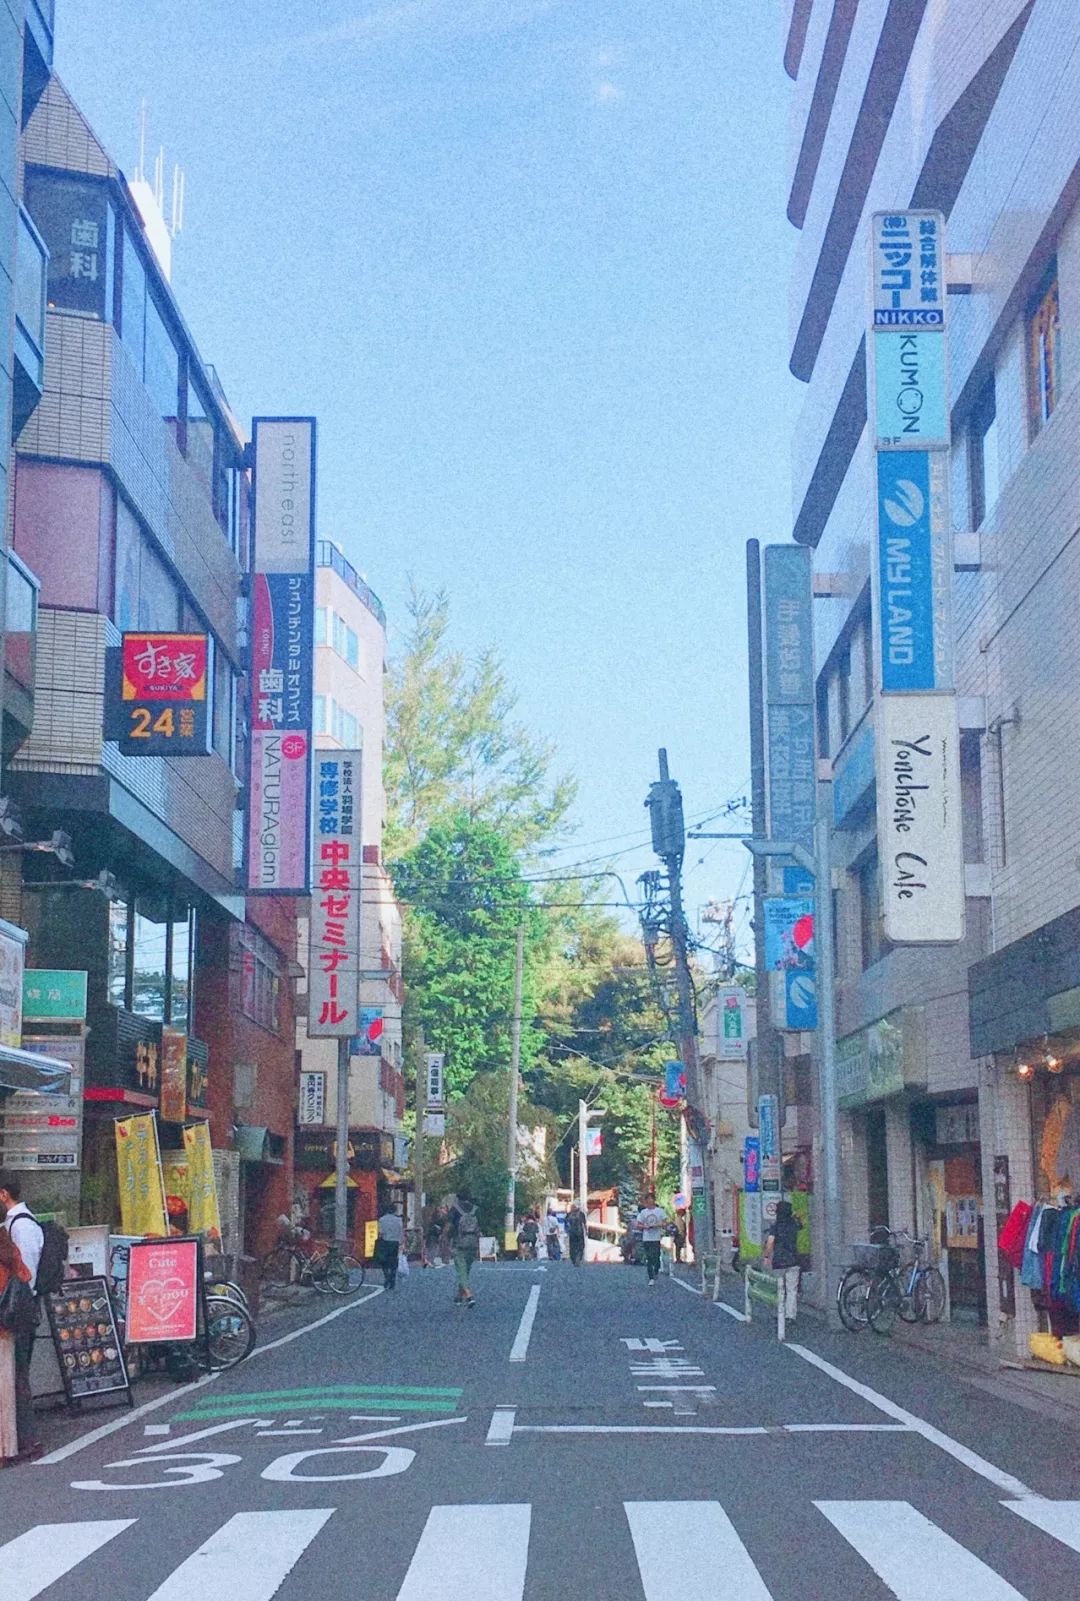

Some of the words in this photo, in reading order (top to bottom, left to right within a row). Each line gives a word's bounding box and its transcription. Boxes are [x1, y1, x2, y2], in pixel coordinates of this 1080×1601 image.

[70, 218, 99, 281] 歯科
[875, 311, 940, 324] NIKKO
[897, 335, 924, 433] KUMON
[887, 588, 914, 666] LAND
[133, 641, 197, 685] すき家
[258, 667, 284, 722] 歯科
[129, 707, 175, 738] 24
[284, 741, 303, 754] 3F
[319, 761, 338, 834] 専修学校
[318, 840, 351, 1026] 中央ゼミナール
[70, 1445, 417, 1491] 30
